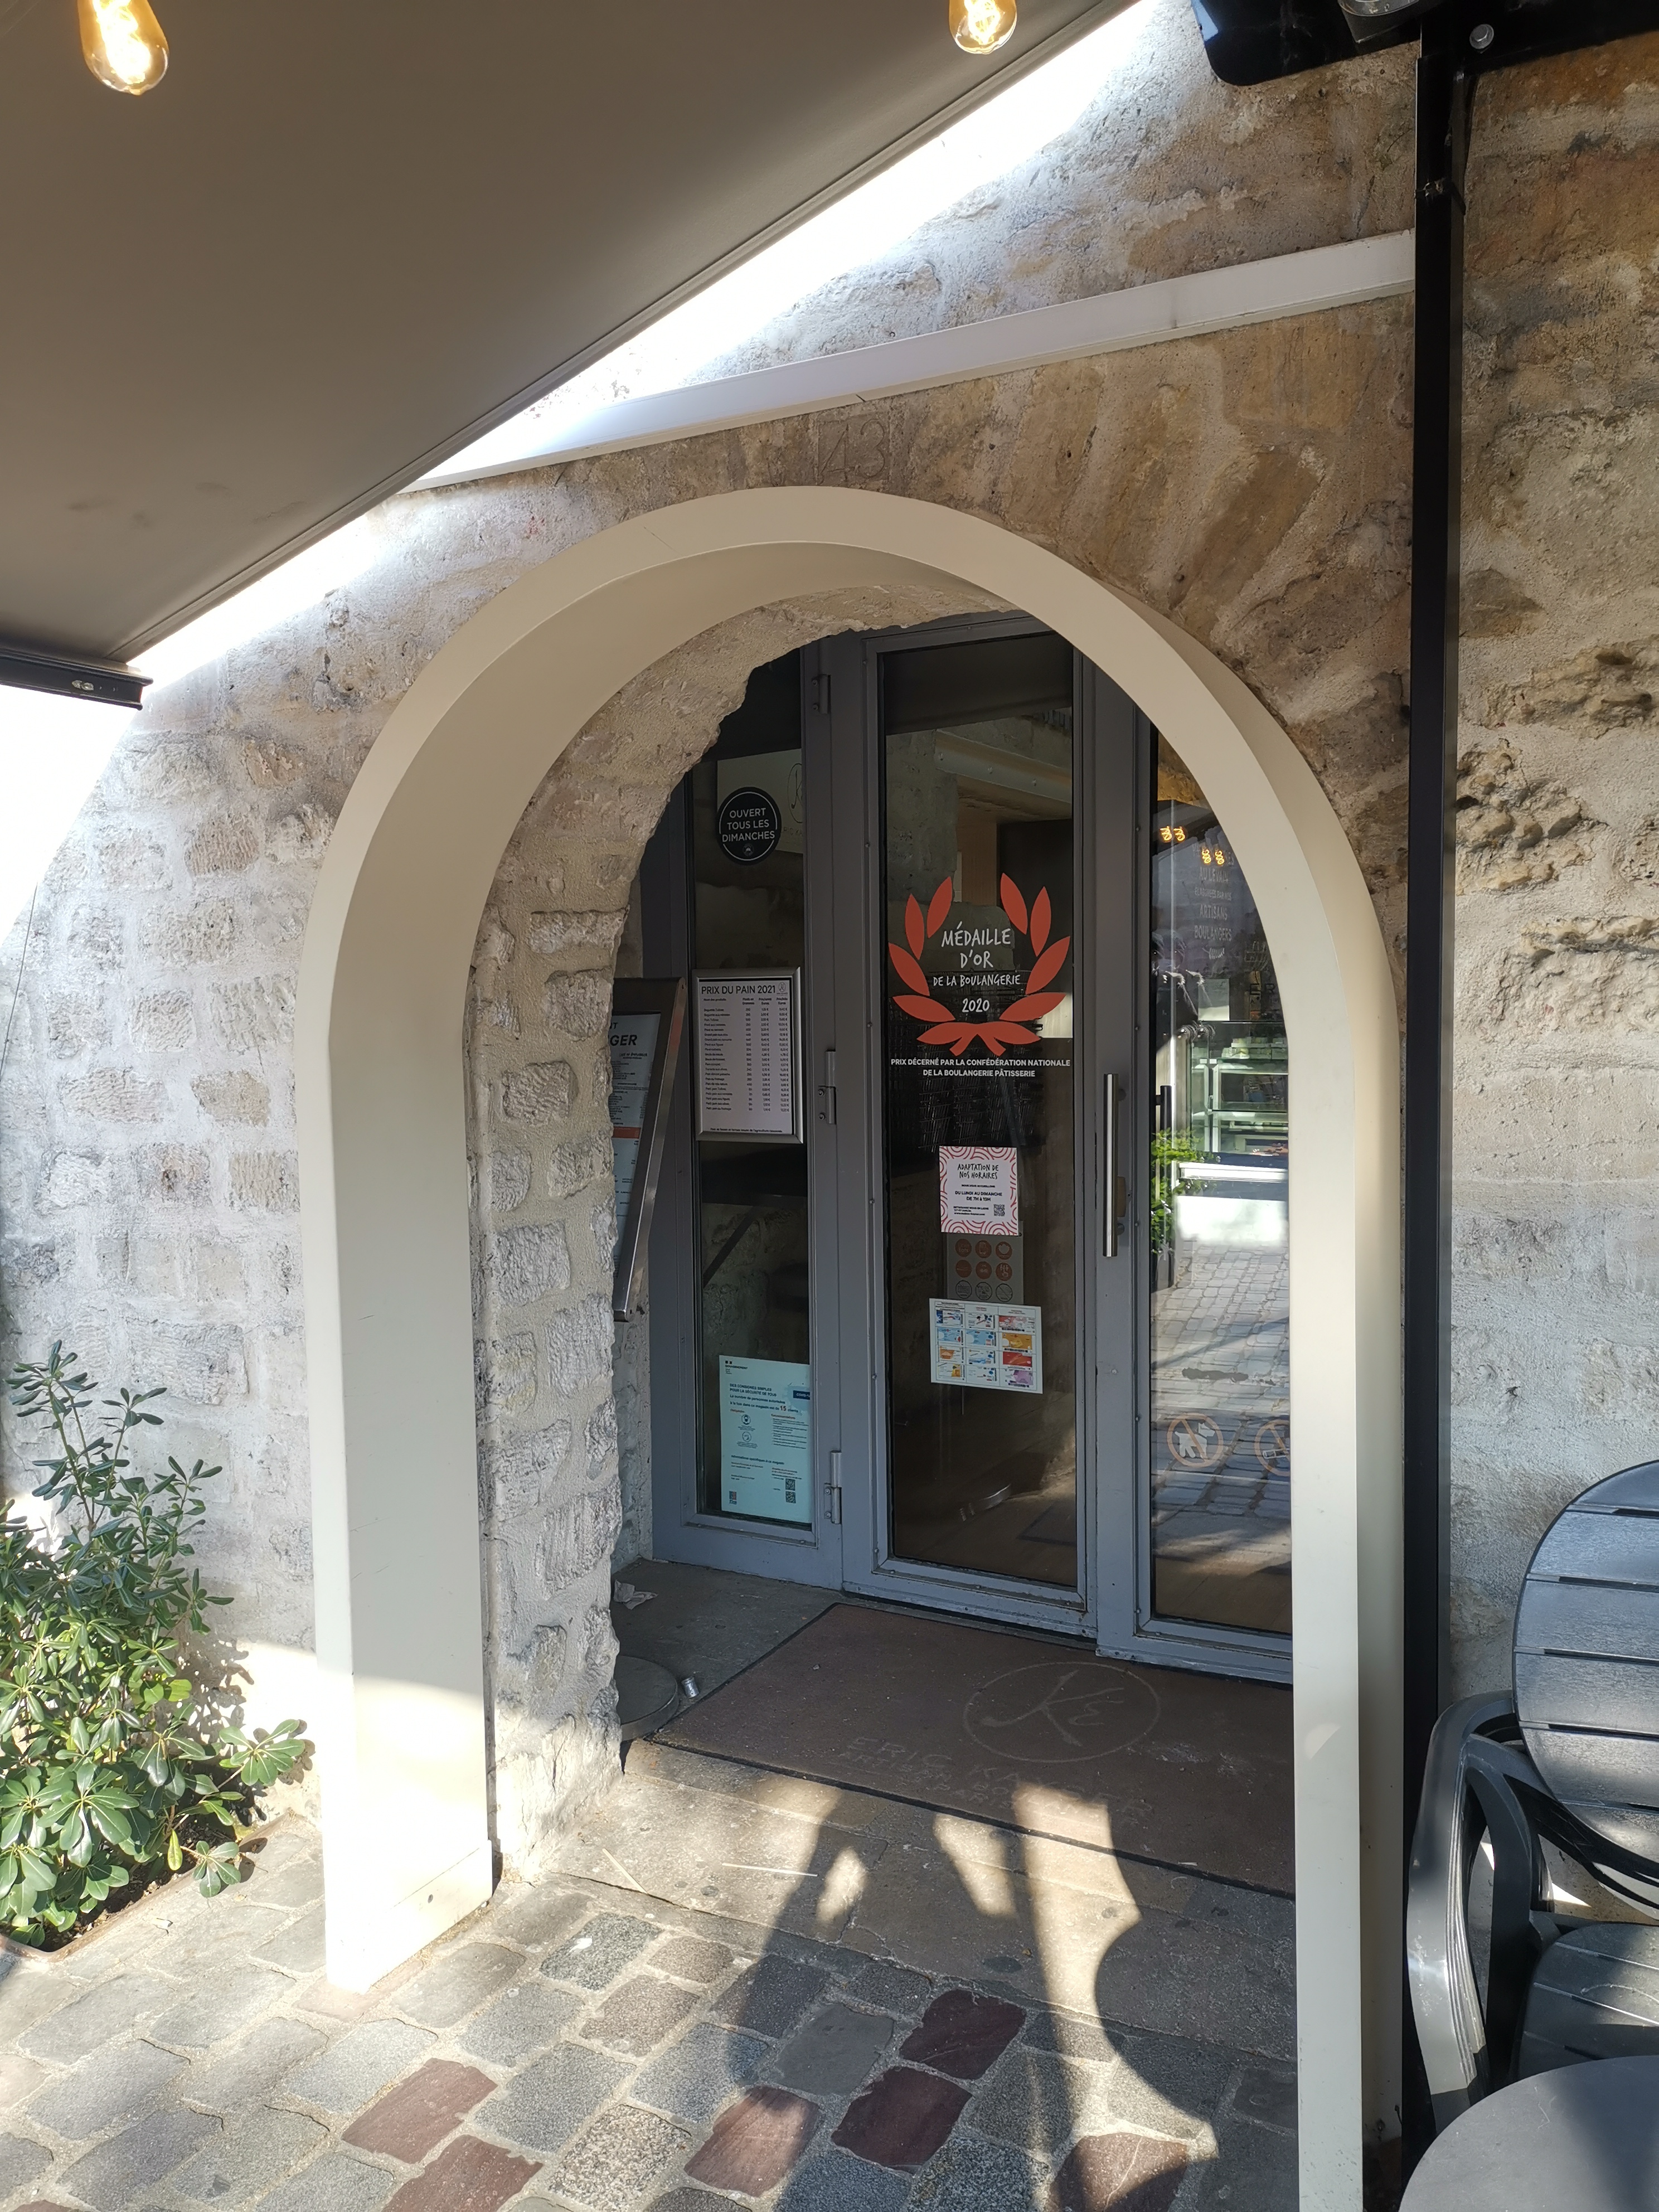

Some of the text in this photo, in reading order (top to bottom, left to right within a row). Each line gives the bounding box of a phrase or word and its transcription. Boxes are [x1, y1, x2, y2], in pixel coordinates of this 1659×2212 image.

[729, 808, 766, 818] OUVERT
[727, 819, 769, 830] TOUS LES
[722, 831, 775, 842] DIMANCHES
[1200, 904, 1228, 920] ARTISANS
[941, 921, 1011, 947] MÉDAILLE
[1194, 925, 1232, 941] BOULANGERS
[960, 949, 993, 968] D'OR
[933, 974, 1021, 987] DE LA BOULANGERIE
[722, 986, 734, 994] DU
[736, 986, 755, 994] PAIN
[758, 985, 775, 993] 2021
[962, 998, 990, 1012] 2020
[966, 1058, 1026, 1066] CONFÉDÉRATION
[995, 1069, 1035, 1077] PÂTISSERIE
